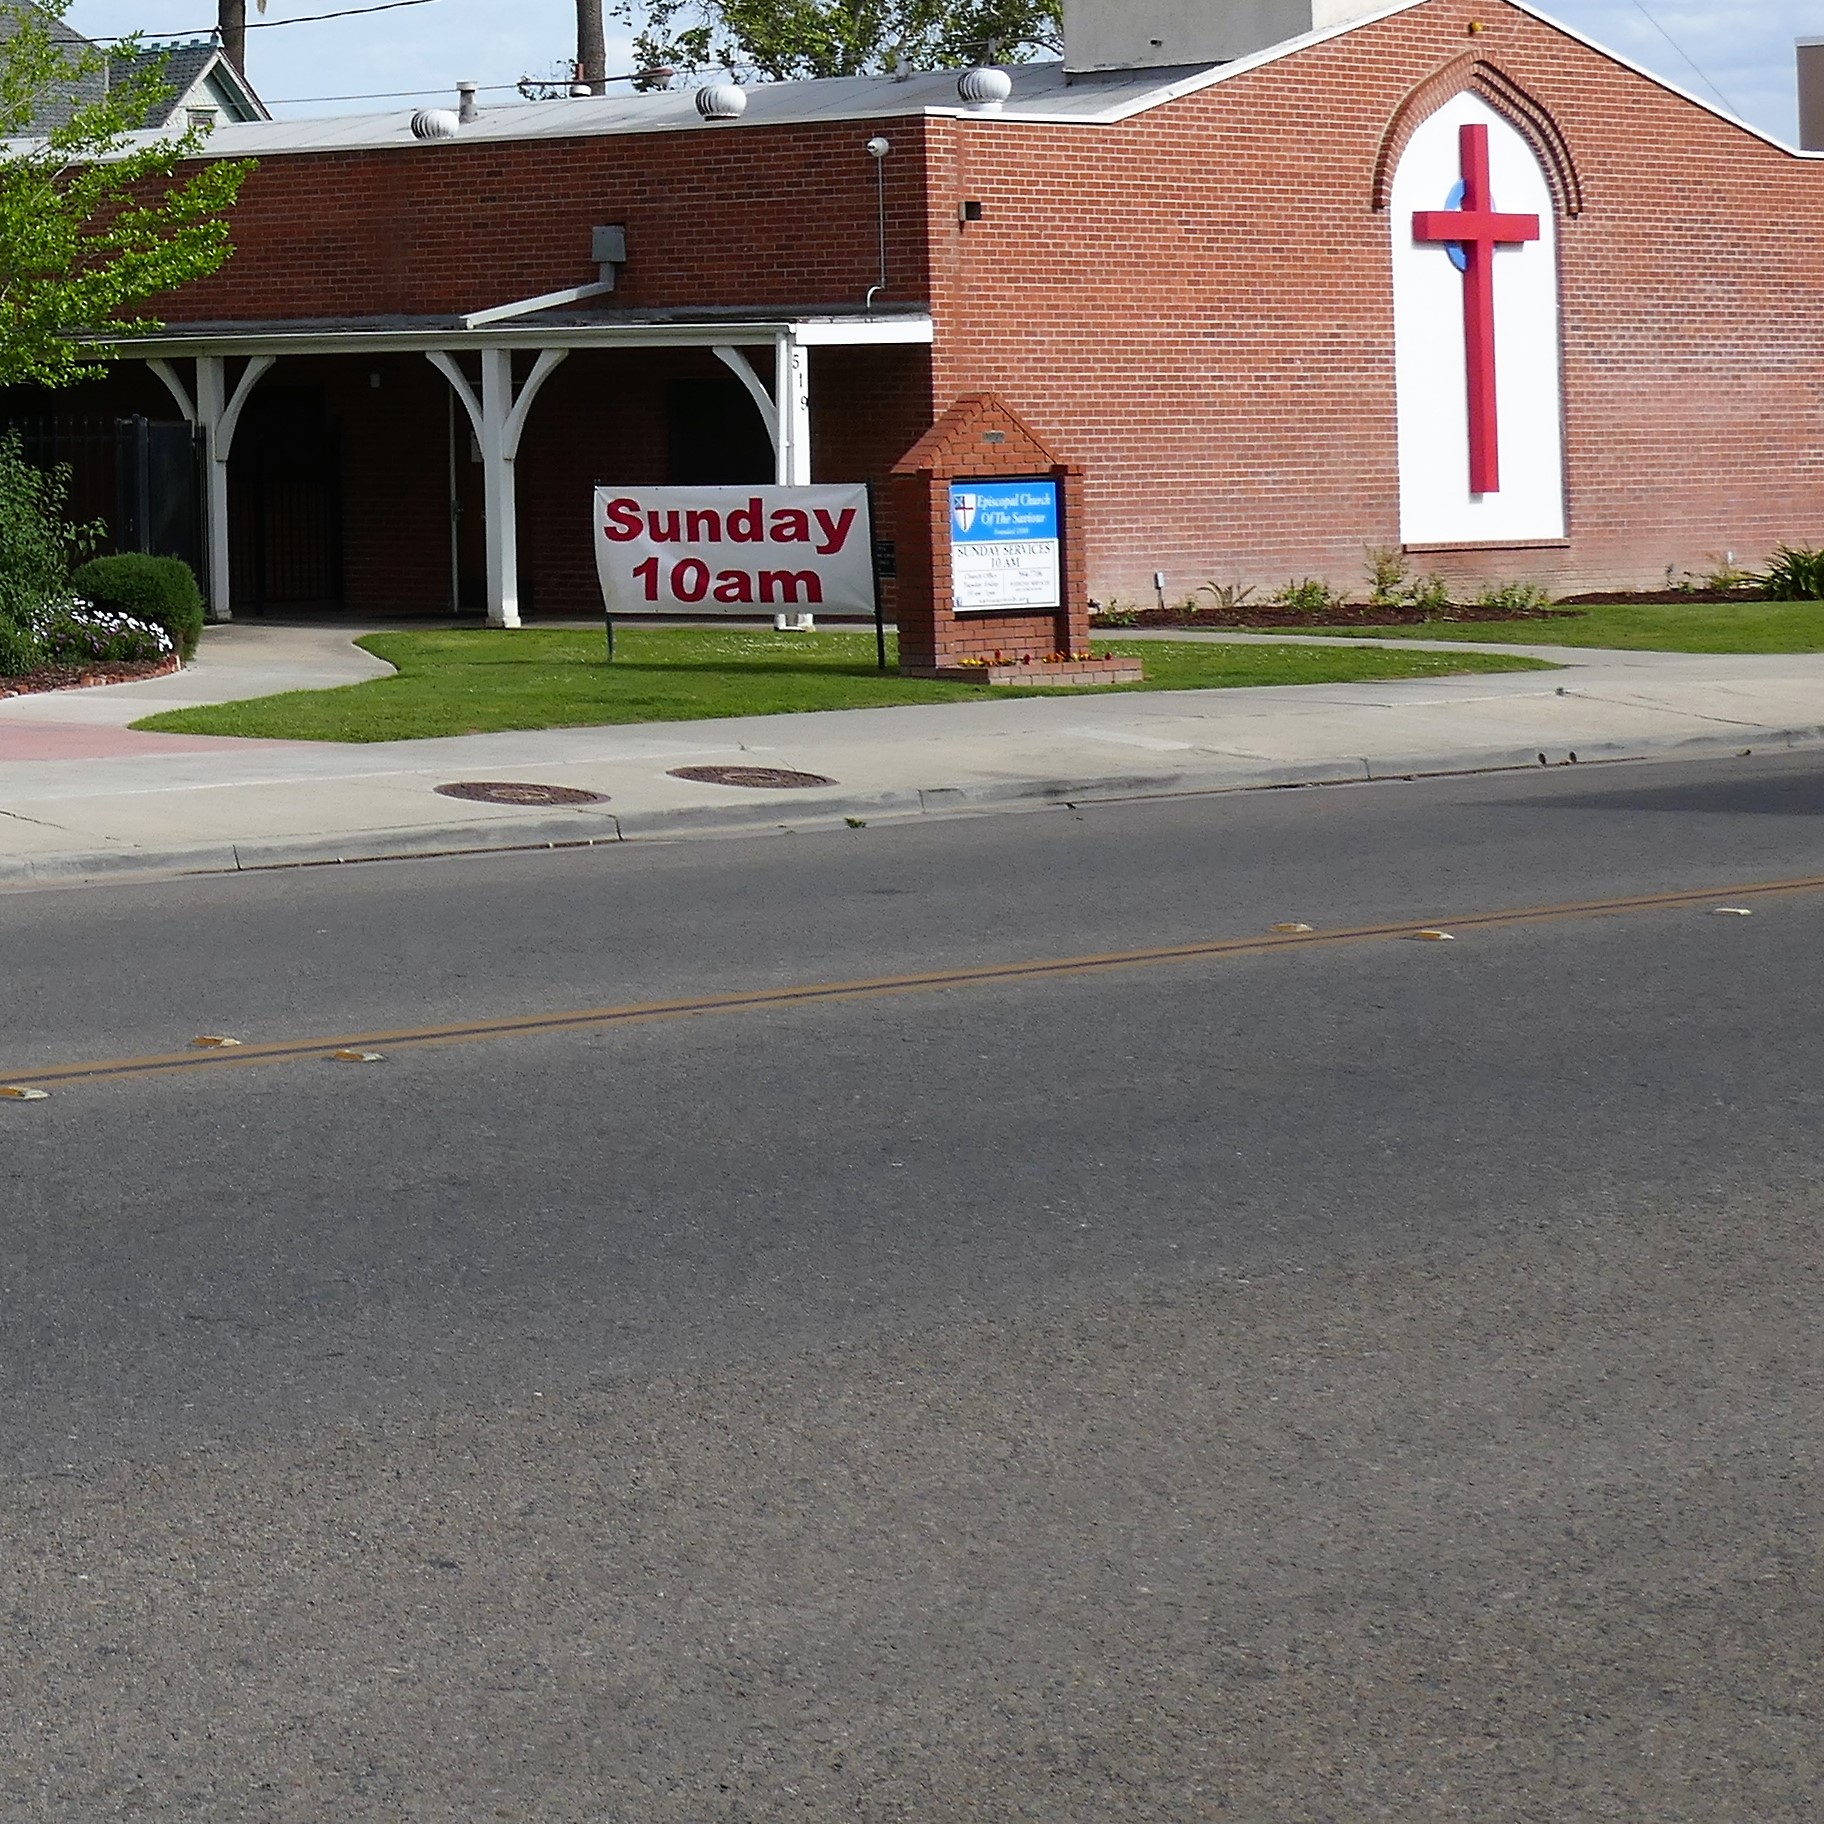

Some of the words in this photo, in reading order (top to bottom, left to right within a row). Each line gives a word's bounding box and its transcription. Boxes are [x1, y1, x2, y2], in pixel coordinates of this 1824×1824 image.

[977, 493, 1020, 510] Episcopal
[1020, 492, 1051, 506] Church
[993, 511, 1011, 524] The
[604, 497, 857, 555] Sunday
[957, 545, 999, 557] SUNDAY
[1002, 543, 1051, 555] SERVICES
[991, 558, 1001, 568] 10
[1003, 557, 1020, 568] AM
[632, 556, 823, 604] 10am
